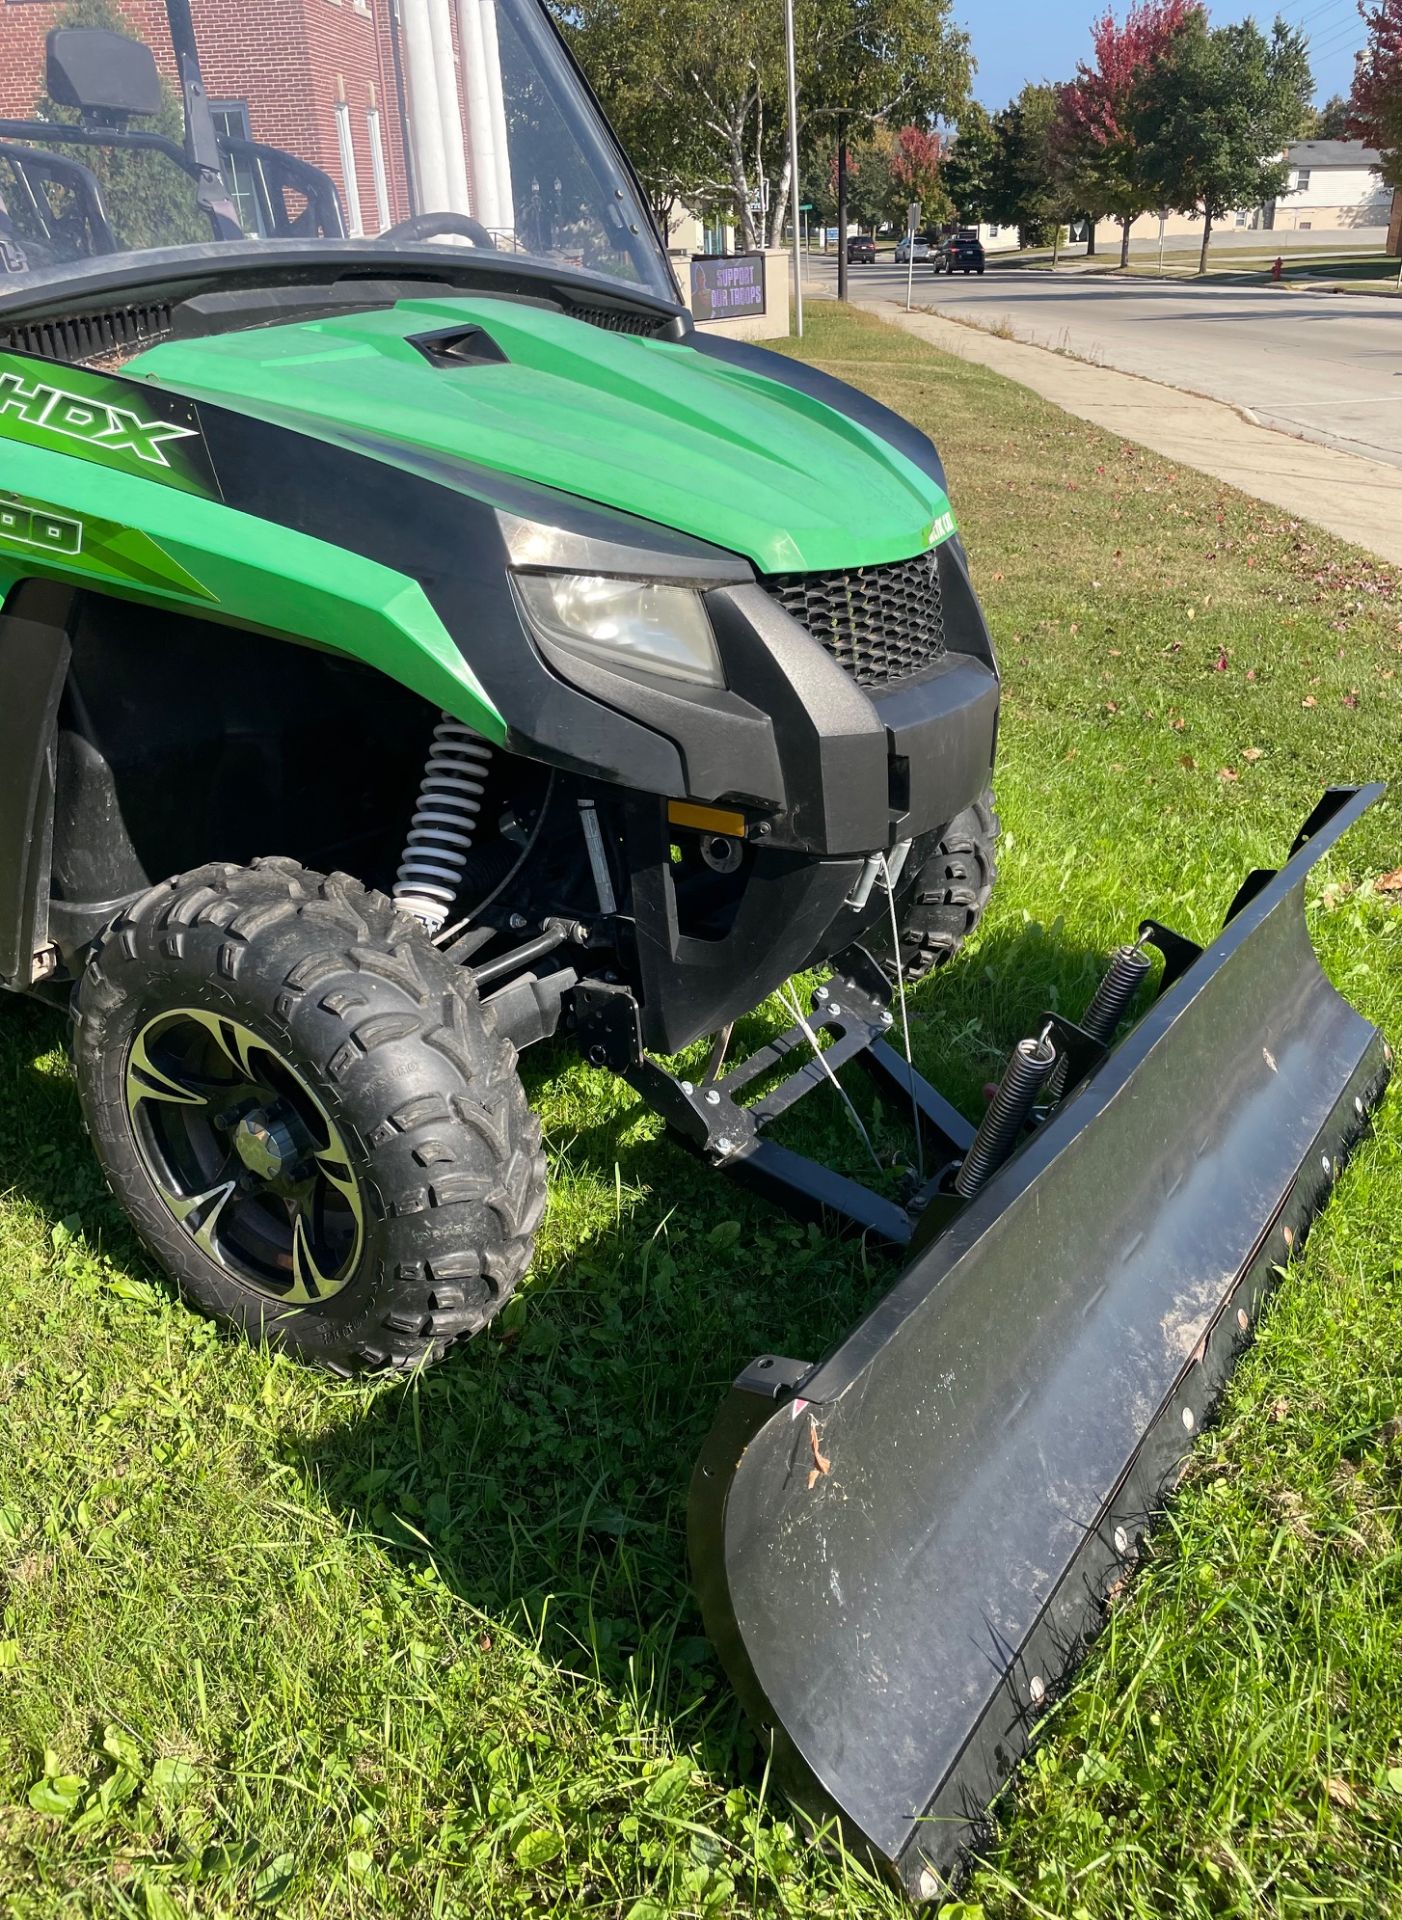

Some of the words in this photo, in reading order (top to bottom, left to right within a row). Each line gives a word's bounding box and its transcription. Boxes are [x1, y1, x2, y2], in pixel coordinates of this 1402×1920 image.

[716, 266, 754, 287] SUPPORT
[711, 288, 728, 308] OUR
[729, 285, 761, 306] TROOPS
[0, 372, 200, 468] HDX
